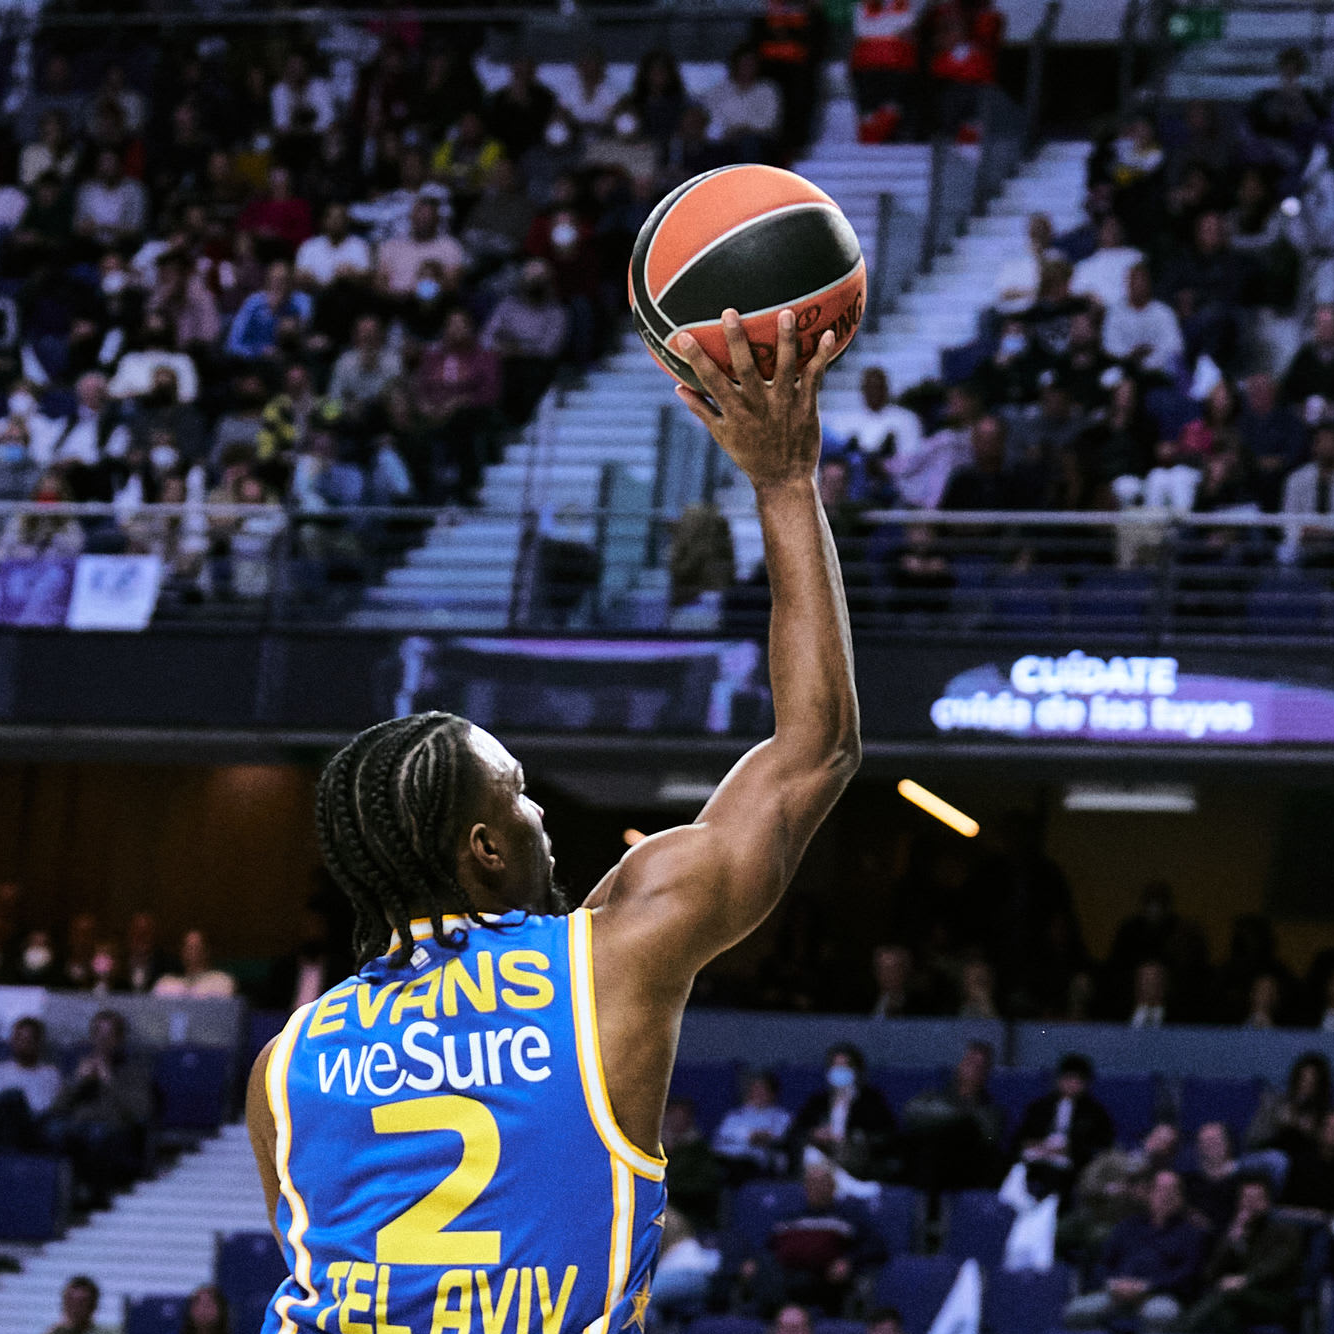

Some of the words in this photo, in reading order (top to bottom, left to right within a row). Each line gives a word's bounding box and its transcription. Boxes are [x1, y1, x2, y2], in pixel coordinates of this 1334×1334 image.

[1010, 650, 1179, 695] CUÍDATE
[930, 692, 1033, 731] cuida
[1035, 695, 1088, 732] de
[1089, 695, 1148, 731] los
[1150, 697, 1254, 738] tuyos
[307, 950, 555, 1039] EVANS
[318, 1021, 552, 1096] weSure
[371, 1094, 501, 1265] 2
